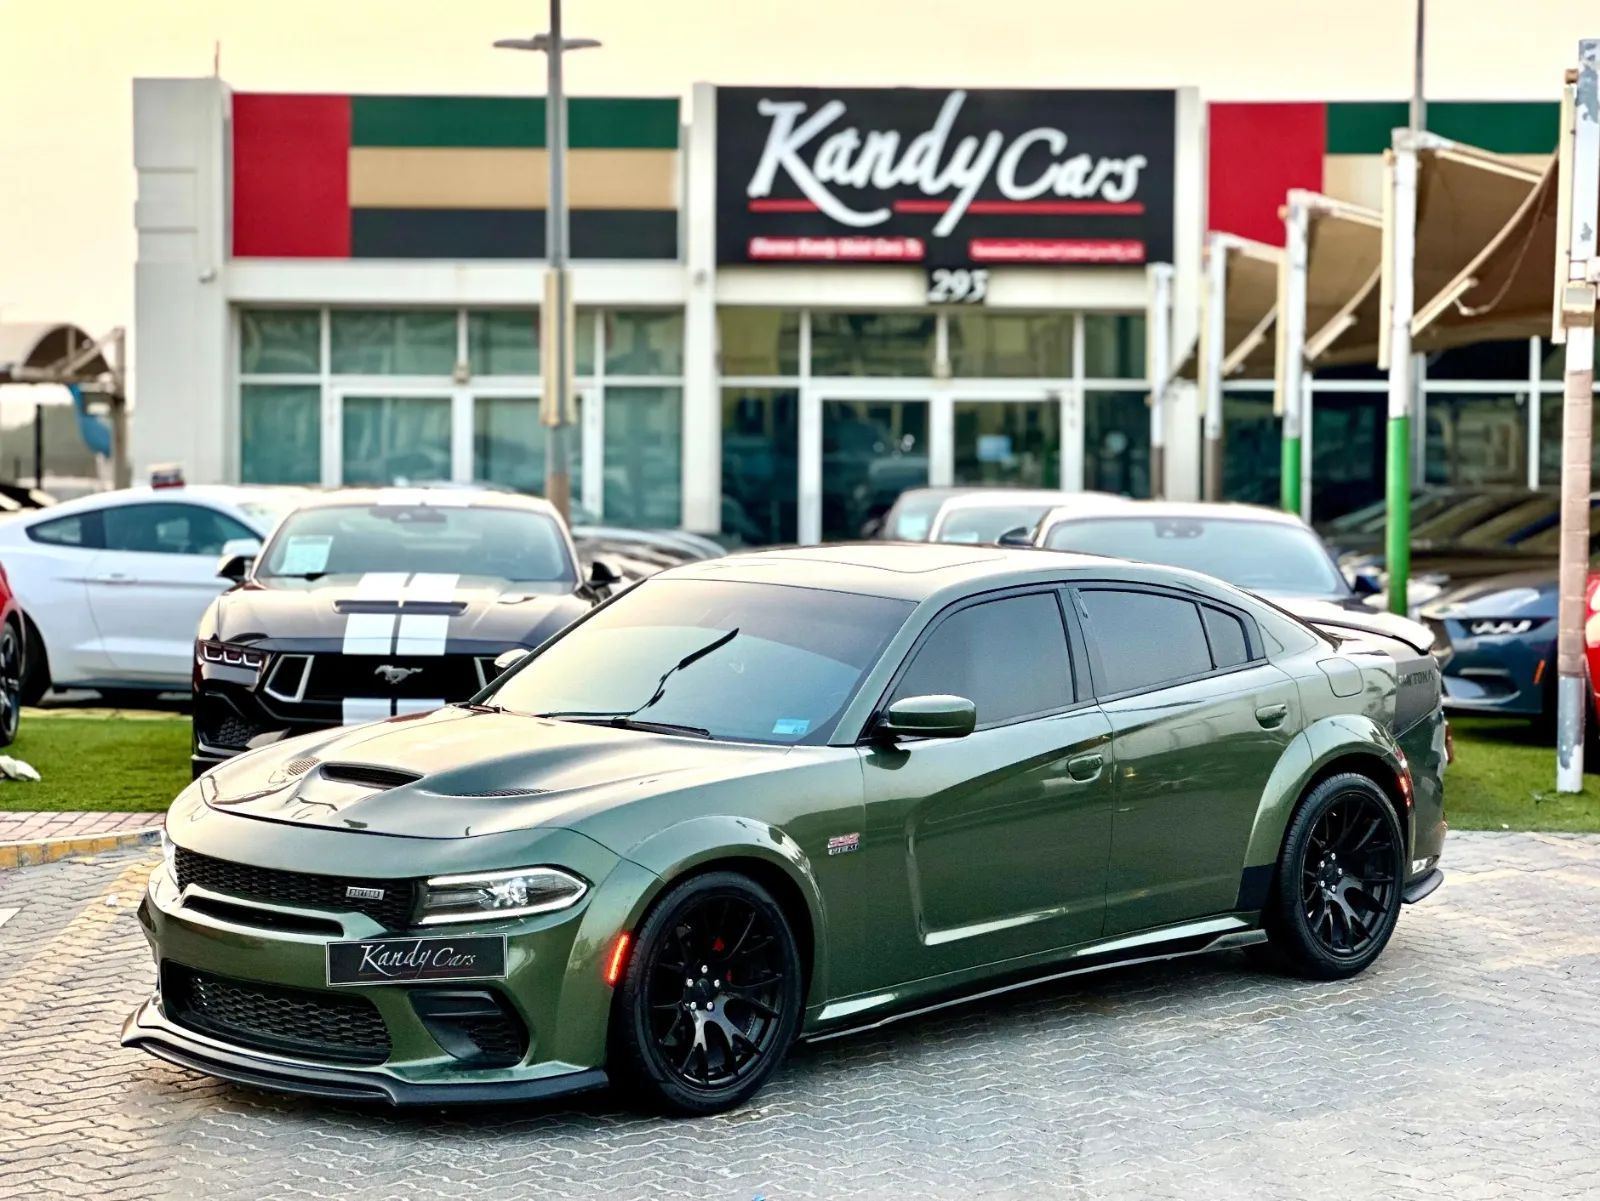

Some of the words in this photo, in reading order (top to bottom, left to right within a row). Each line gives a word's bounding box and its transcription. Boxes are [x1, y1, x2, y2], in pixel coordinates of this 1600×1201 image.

[746, 90, 1004, 238] Kandy
[996, 127, 1148, 203] Cars
[927, 268, 989, 303] 295
[358, 939, 432, 979] Kandy
[432, 947, 477, 967] Cars
